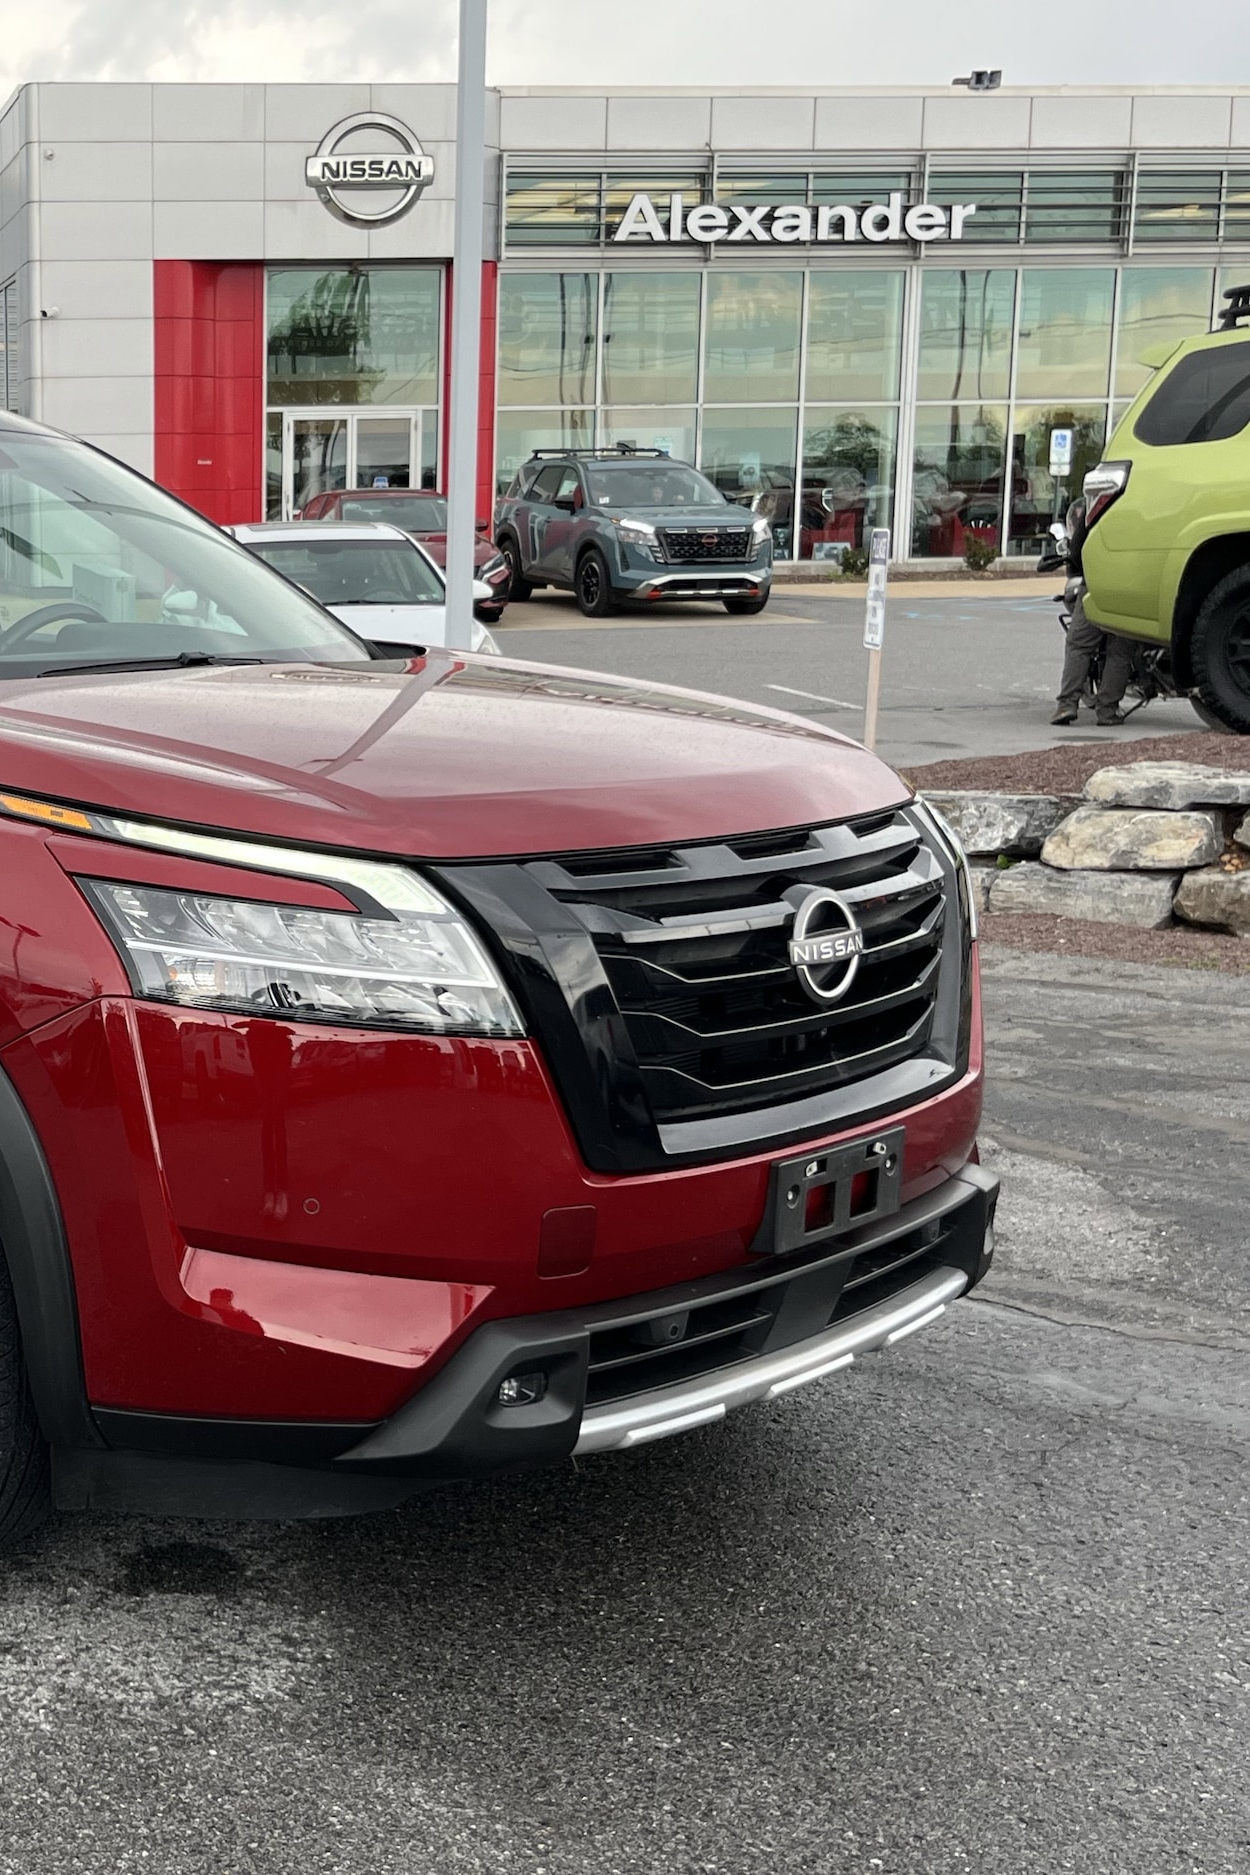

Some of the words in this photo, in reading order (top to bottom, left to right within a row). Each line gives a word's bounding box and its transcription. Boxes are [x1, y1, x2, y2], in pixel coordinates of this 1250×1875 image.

[320, 160, 422, 180] NISSAN
[613, 192, 977, 243] Alexander
[792, 934, 863, 962] NISSAN
